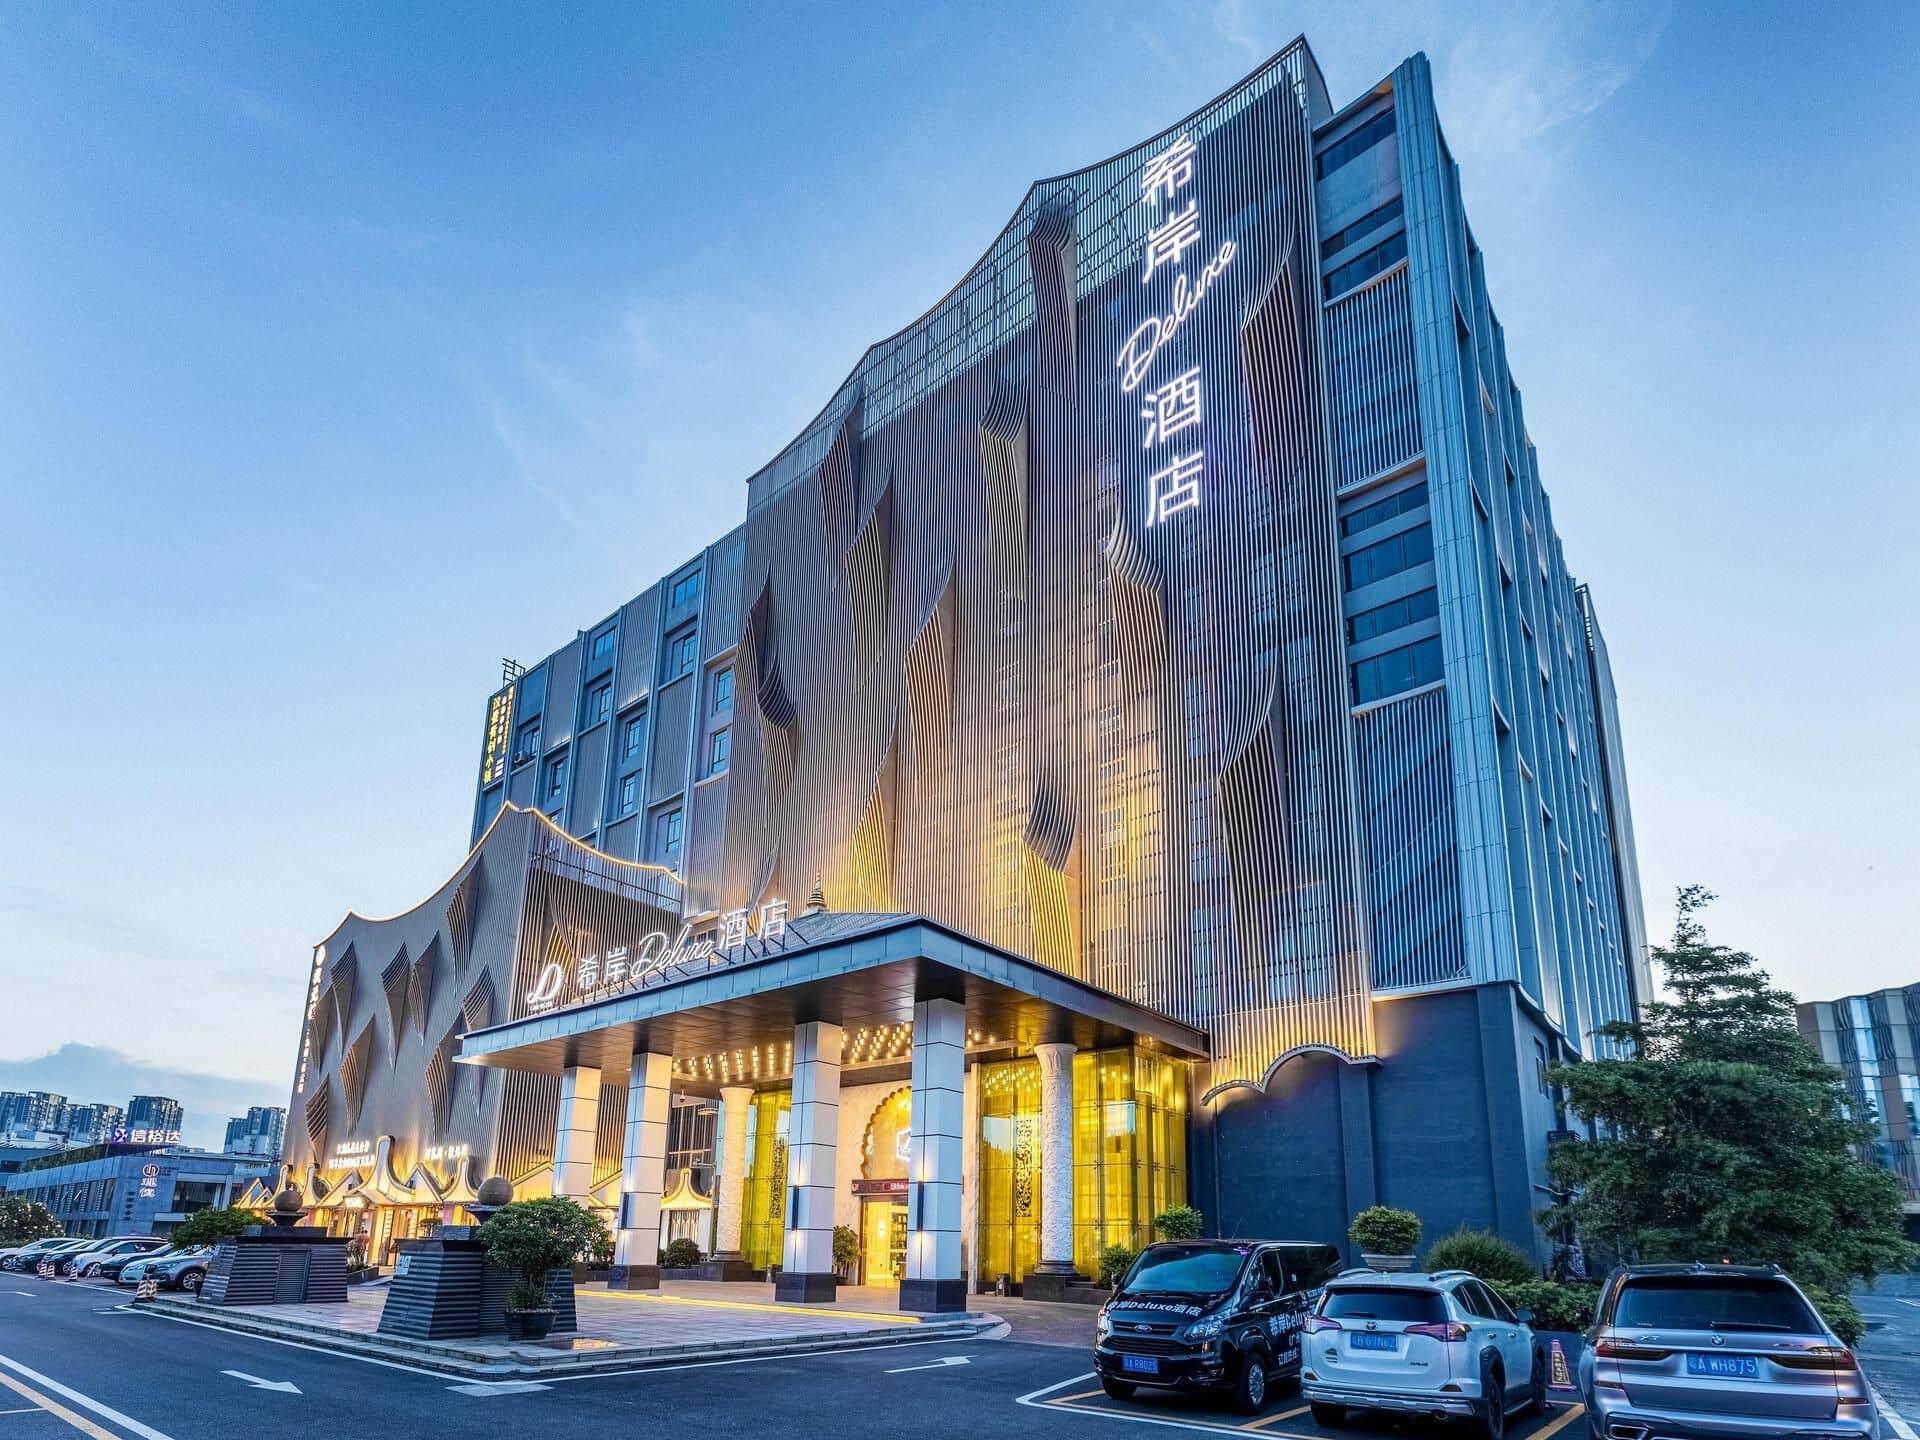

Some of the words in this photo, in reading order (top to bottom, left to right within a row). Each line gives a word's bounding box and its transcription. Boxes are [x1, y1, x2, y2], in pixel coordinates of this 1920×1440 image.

[1141, 133, 1200, 284] 希岸
[1117, 240, 1237, 393] Deluxe
[1141, 366, 1204, 528] 酒店
[577, 946, 628, 990] 希岸
[629, 922, 714, 978] Deluxe
[719, 898, 789, 951] 酒店
